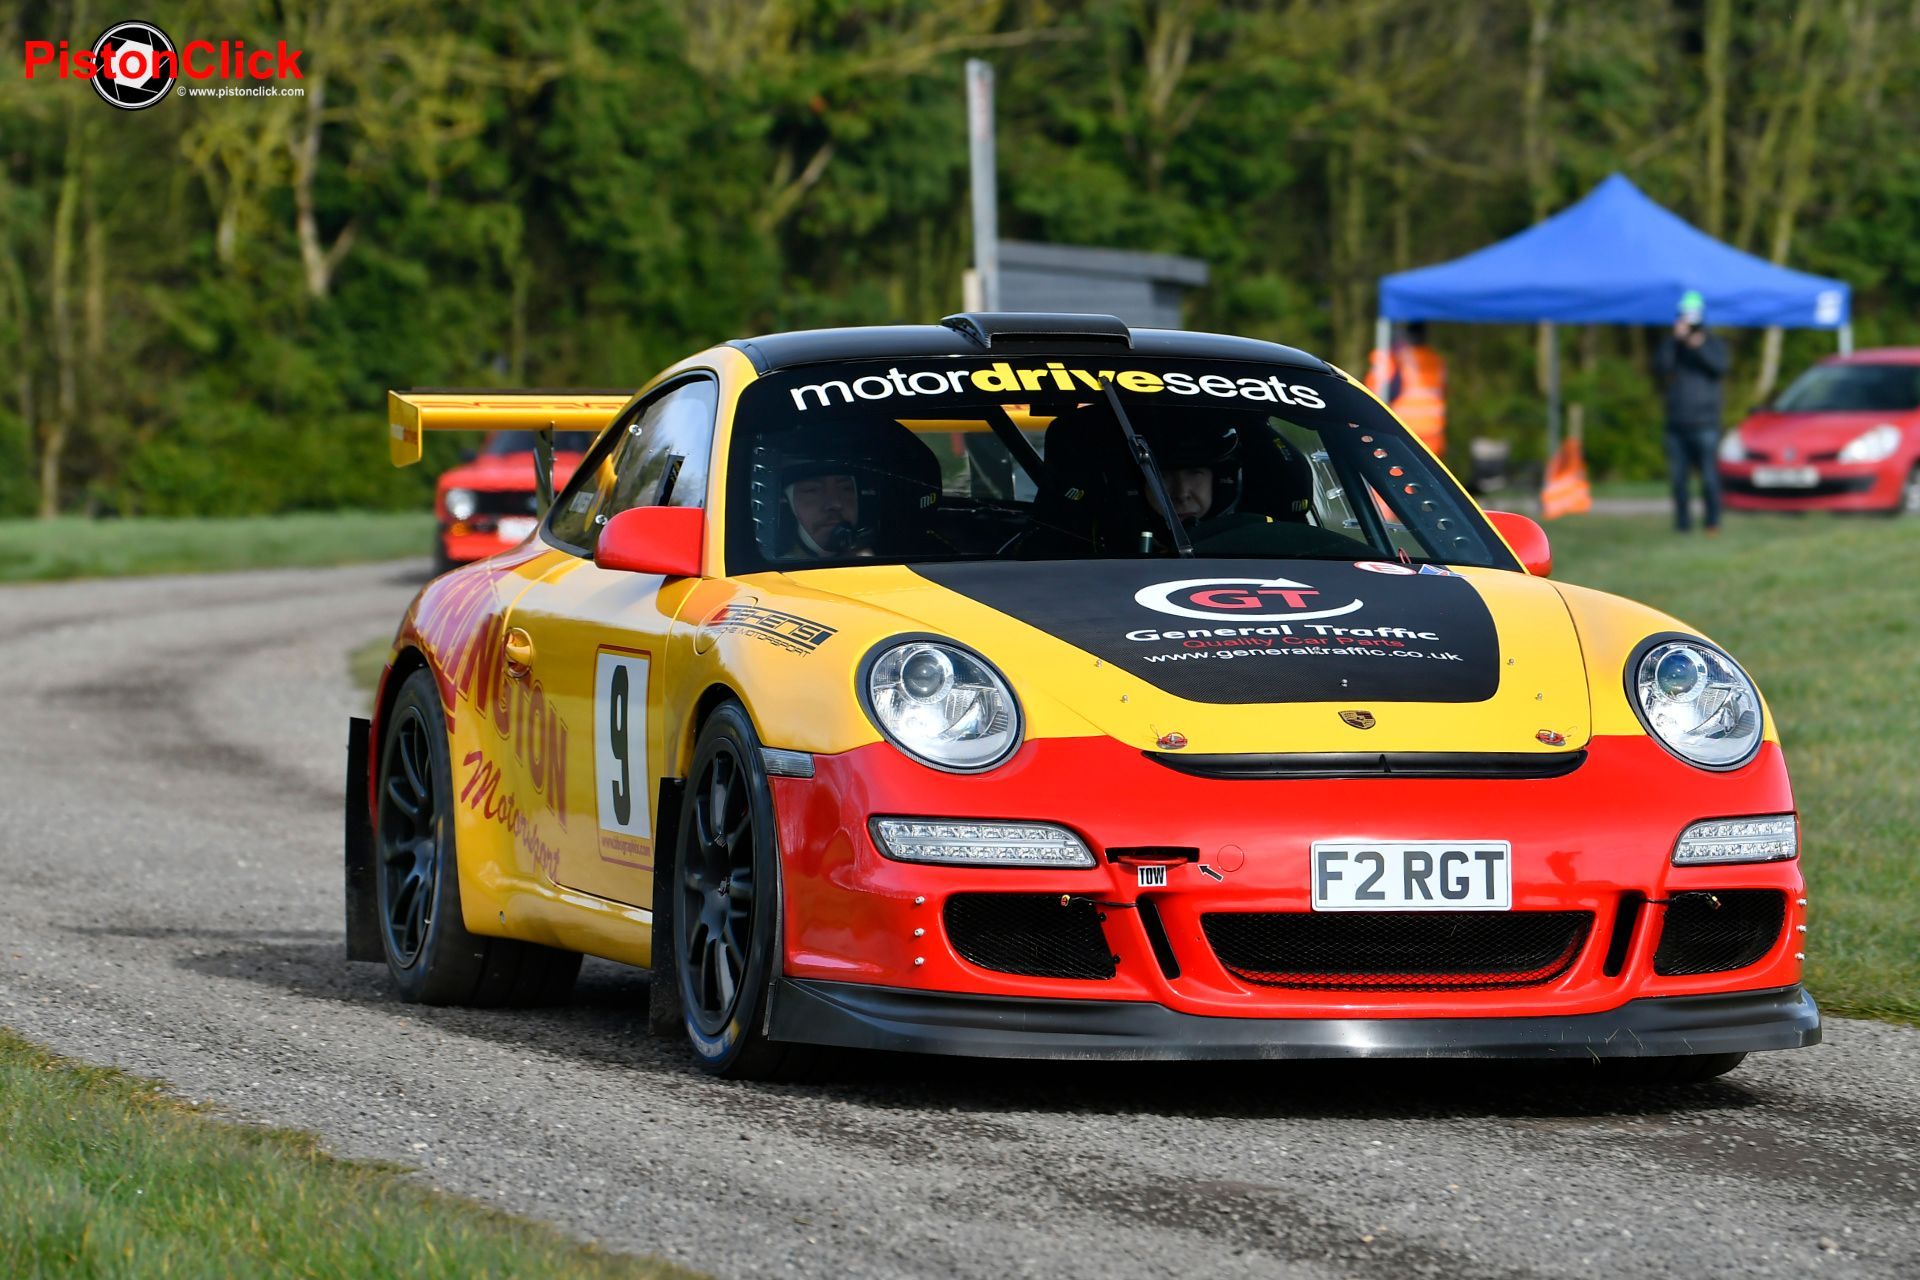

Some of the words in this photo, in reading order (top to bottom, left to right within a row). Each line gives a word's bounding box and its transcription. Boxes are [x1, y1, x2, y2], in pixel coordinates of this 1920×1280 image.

[1189, 589, 1320, 609] GT
[1125, 624, 1293, 642] General
[1303, 624, 1440, 641] Traffic
[1182, 637, 1273, 649] Quality
[1282, 637, 1328, 645] Car
[1335, 637, 1406, 648] Parts
[1143, 646, 1464, 663] www.generaltraffic.co.uk
[610, 664, 631, 826] 9
[460, 750, 560, 881] Motorsport
[1138, 867, 1165, 886] TOW
[1317, 851, 1386, 900] F2
[1403, 851, 1505, 900] RGT
